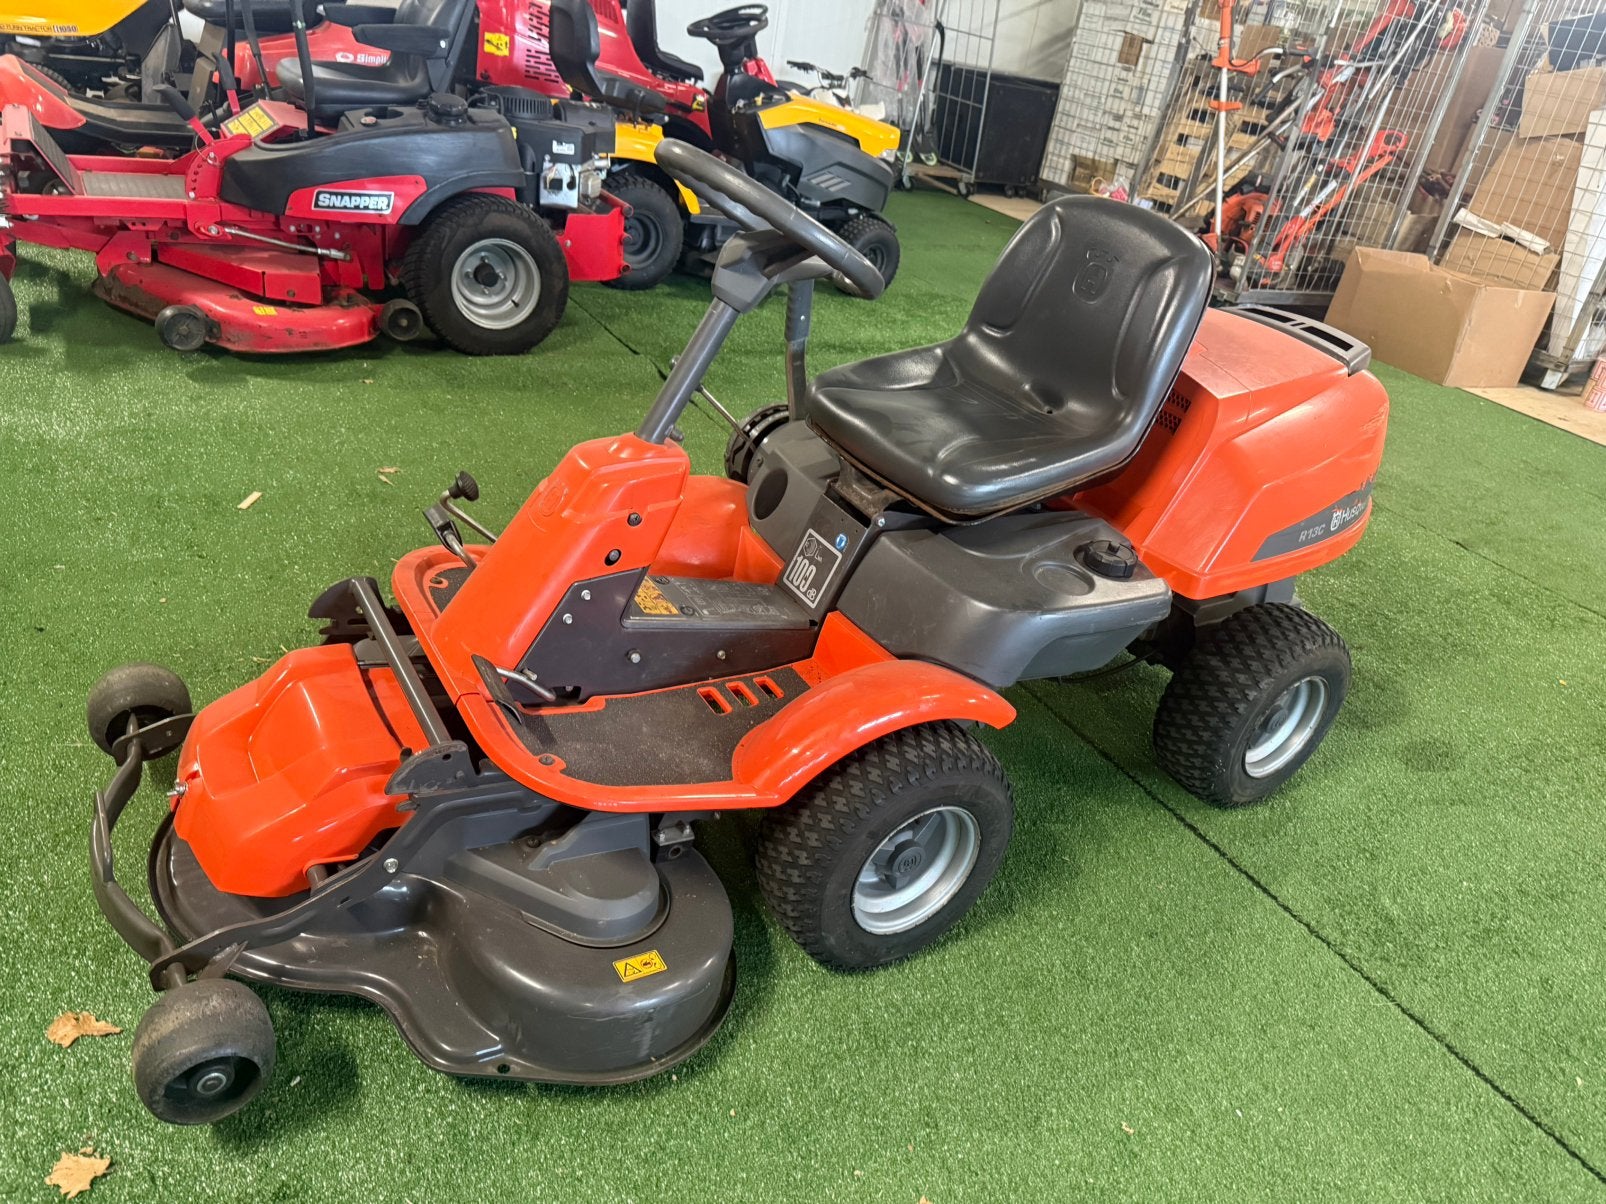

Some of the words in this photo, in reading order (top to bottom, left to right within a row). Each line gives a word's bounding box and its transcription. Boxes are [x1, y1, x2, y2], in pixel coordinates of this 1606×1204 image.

[318, 193, 389, 210] SNAPPER
[1298, 523, 1326, 542] R13C
[806, 588, 817, 601] dB
